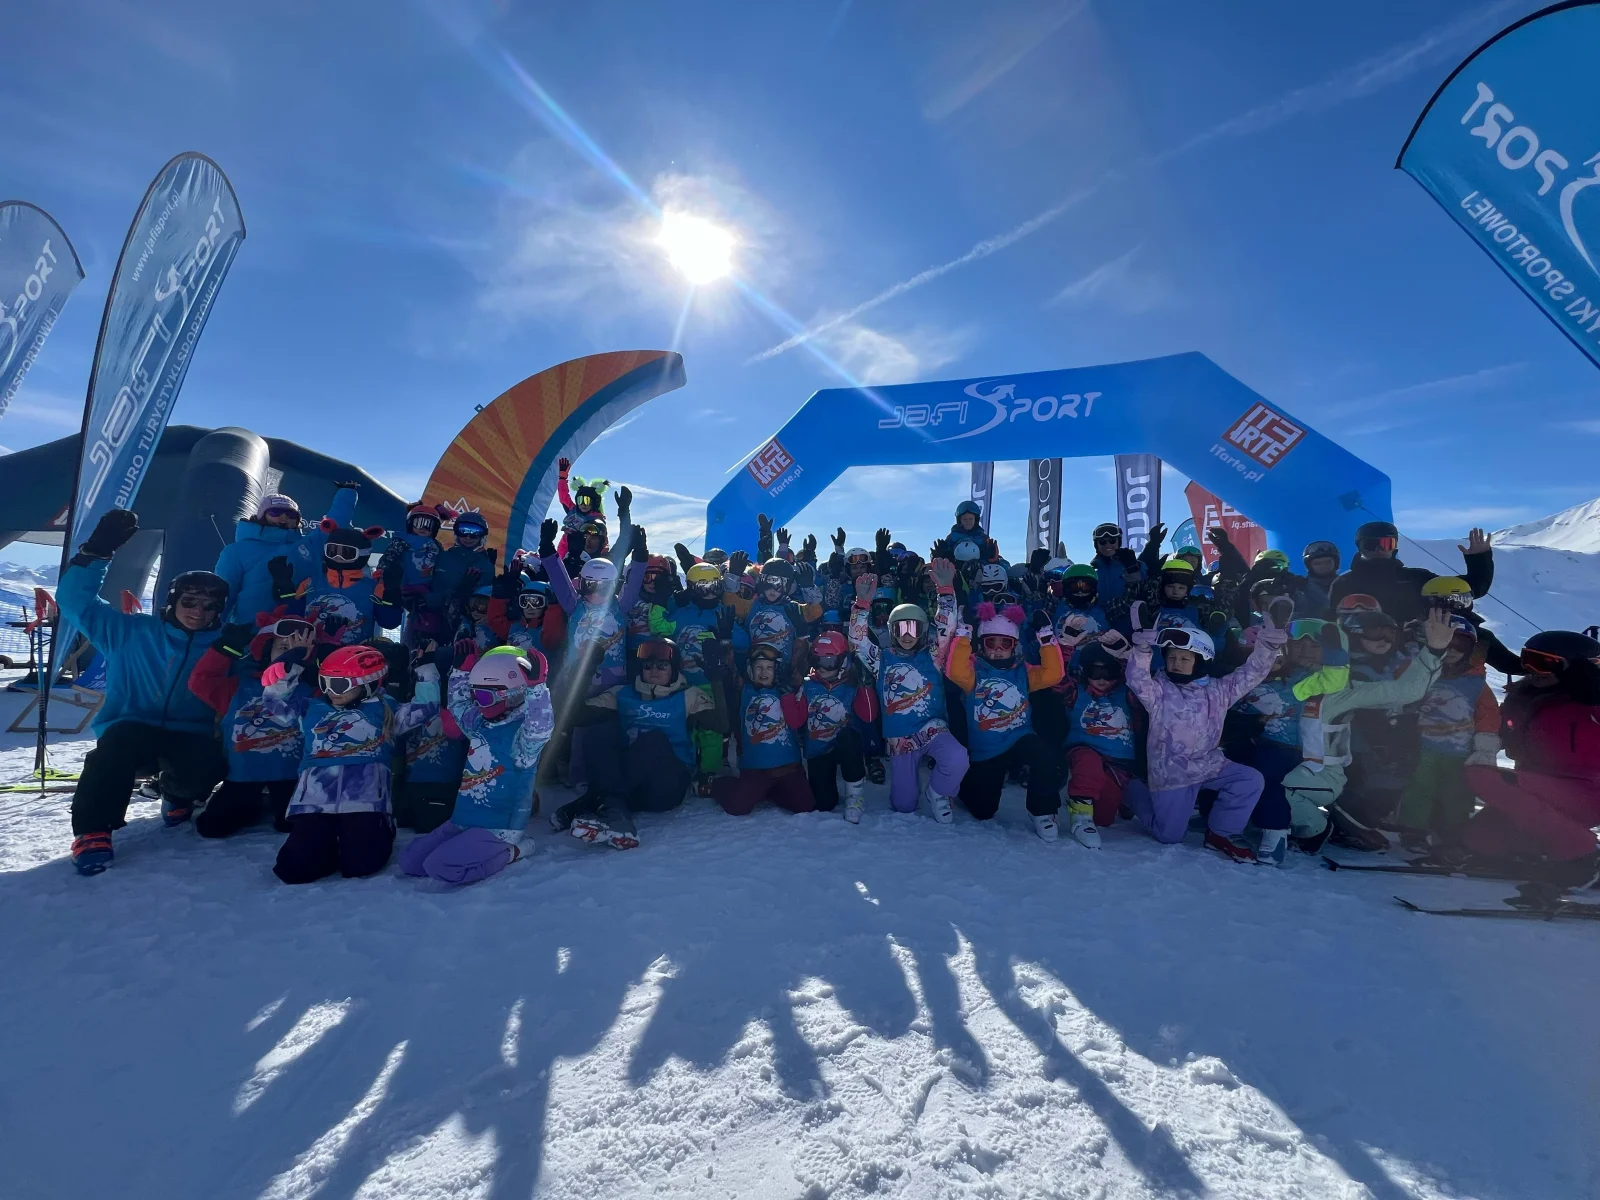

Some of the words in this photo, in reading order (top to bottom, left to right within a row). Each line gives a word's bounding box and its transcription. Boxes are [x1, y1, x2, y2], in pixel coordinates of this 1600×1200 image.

[131, 189, 181, 282] www.jafisport.pl
[155, 196, 226, 325] SPORT
[13, 309, 58, 387] SPORTOWEJ
[114, 452, 145, 510] BIURO
[139, 361, 182, 451] TURYSTYKI
[923, 379, 1102, 443] SPORT
[769, 464, 804, 497] ITarte.pl
[1209, 444, 1265, 482] ITarte.pl
[636, 703, 671, 719] SPORT
